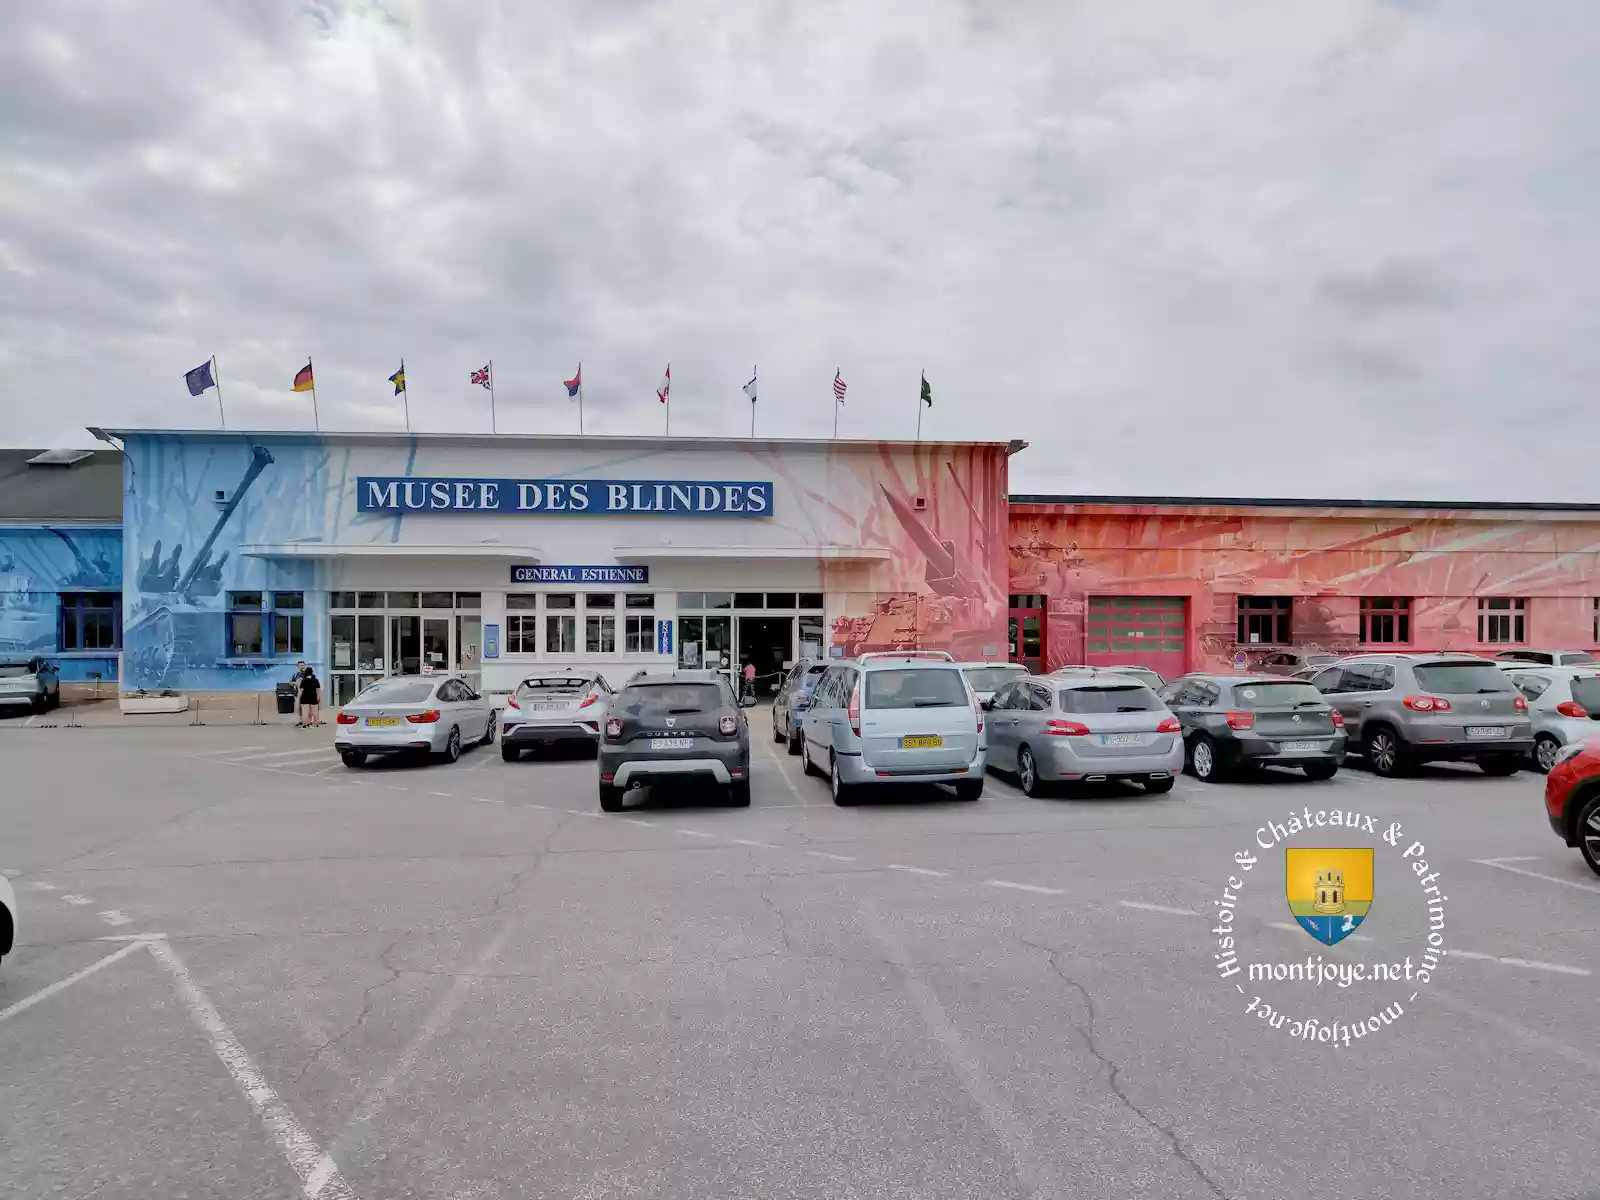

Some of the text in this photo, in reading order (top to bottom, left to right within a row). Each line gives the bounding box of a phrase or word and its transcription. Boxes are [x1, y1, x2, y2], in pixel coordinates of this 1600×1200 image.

[366, 481, 766, 512] MUSEE DES BLINDES
[515, 568, 644, 580] GENERAL ESTIENNE
